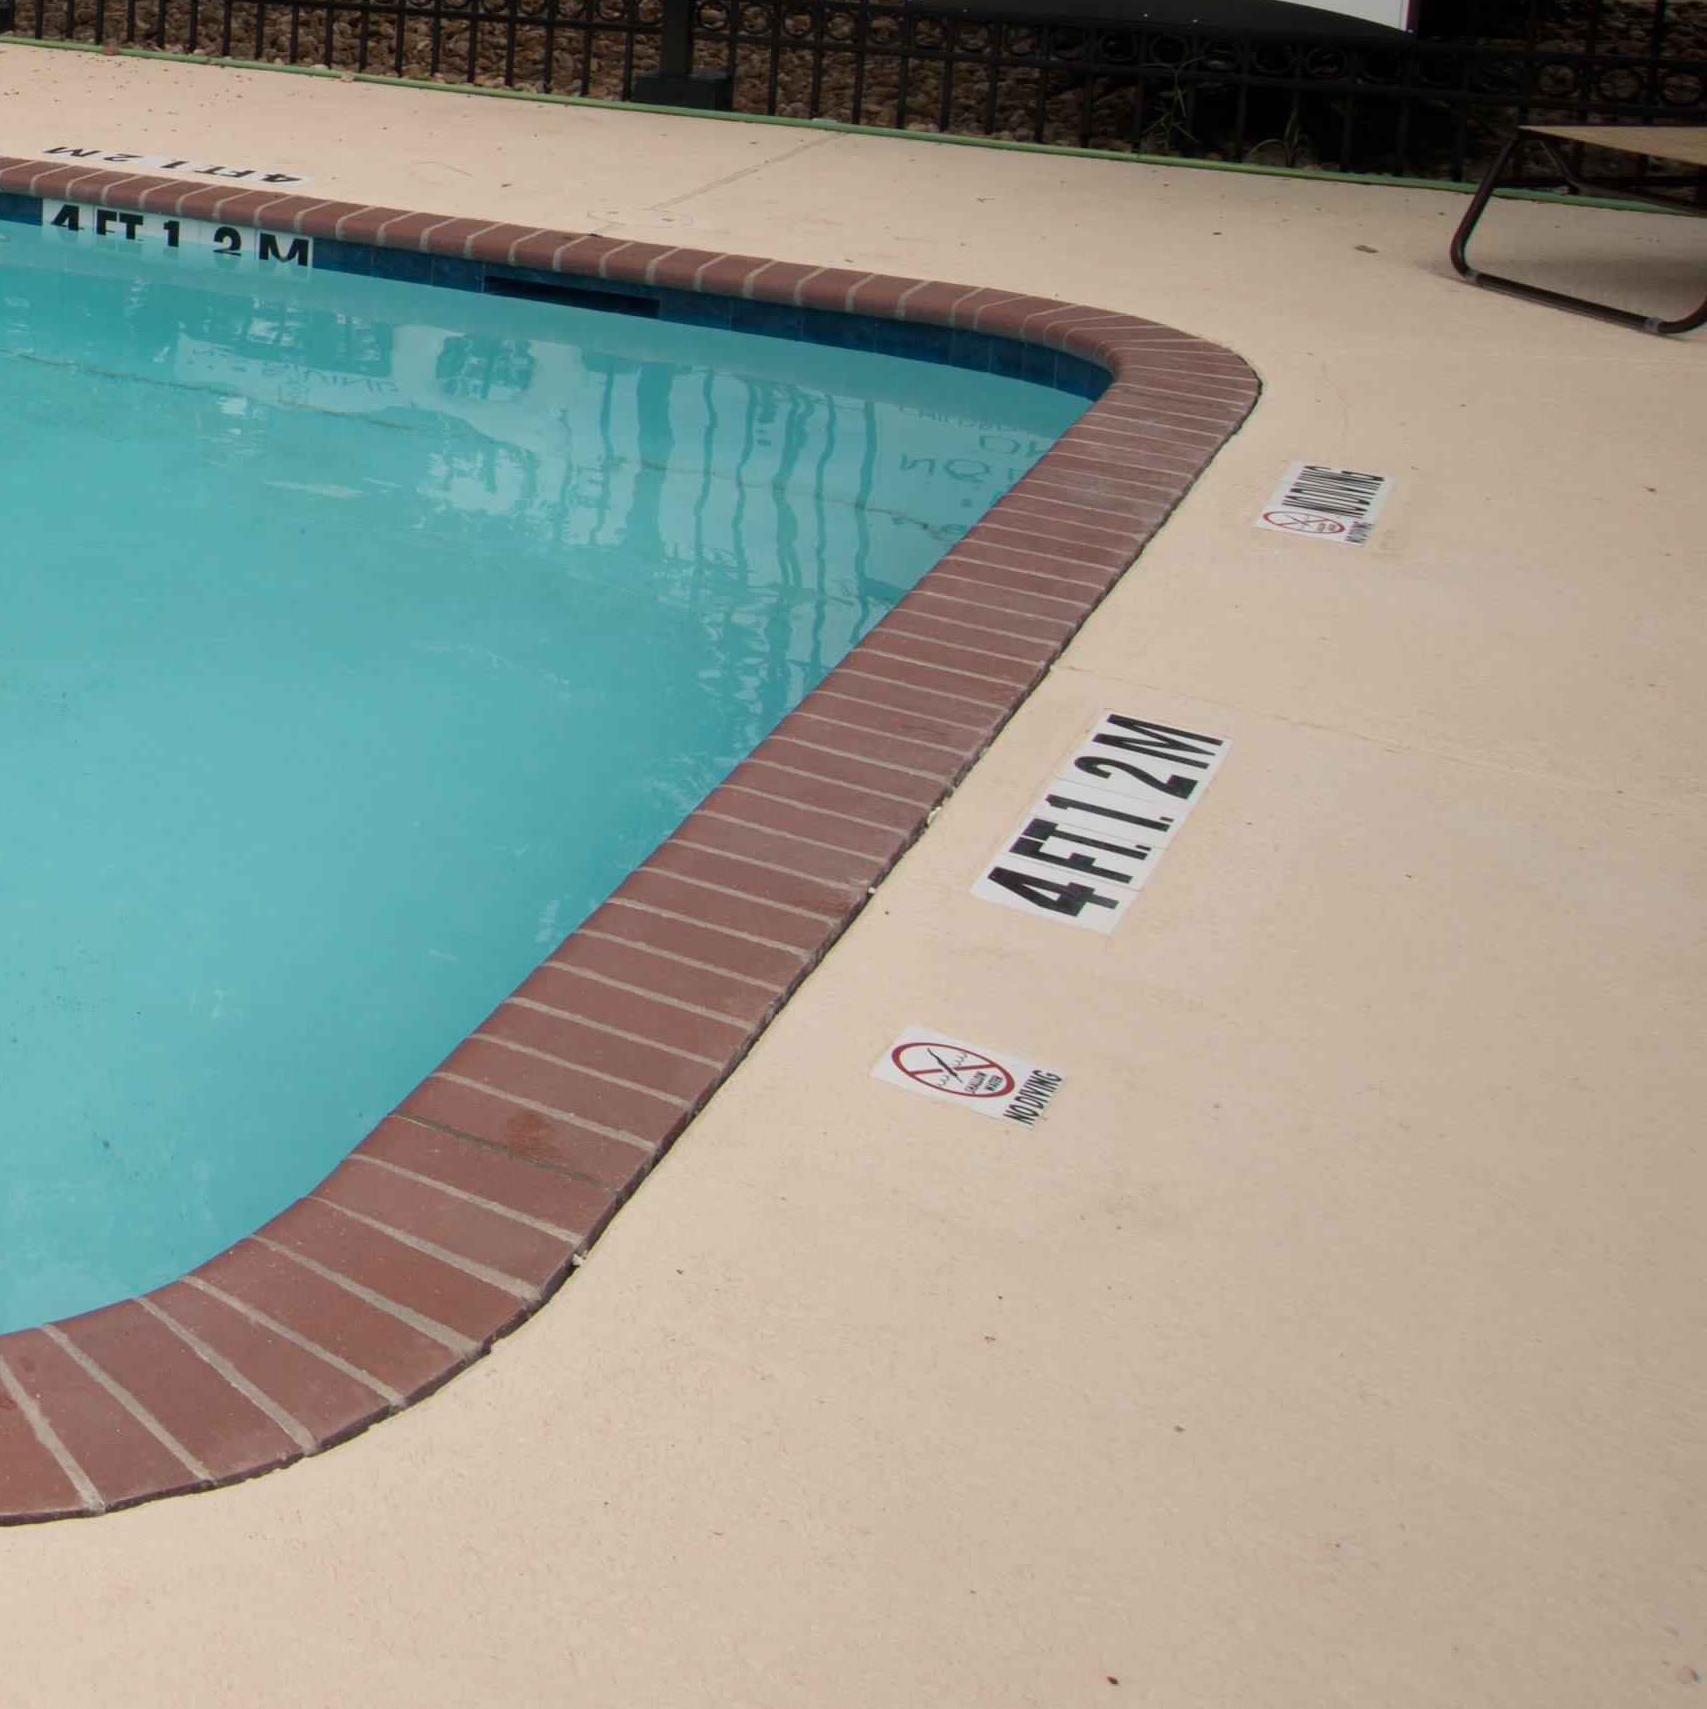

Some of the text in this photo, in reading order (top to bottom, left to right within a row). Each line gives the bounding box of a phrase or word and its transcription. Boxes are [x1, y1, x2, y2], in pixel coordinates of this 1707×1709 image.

[1281, 465, 1385, 519] NO DIVING
[1002, 1070, 1064, 1126] NO DIVING
